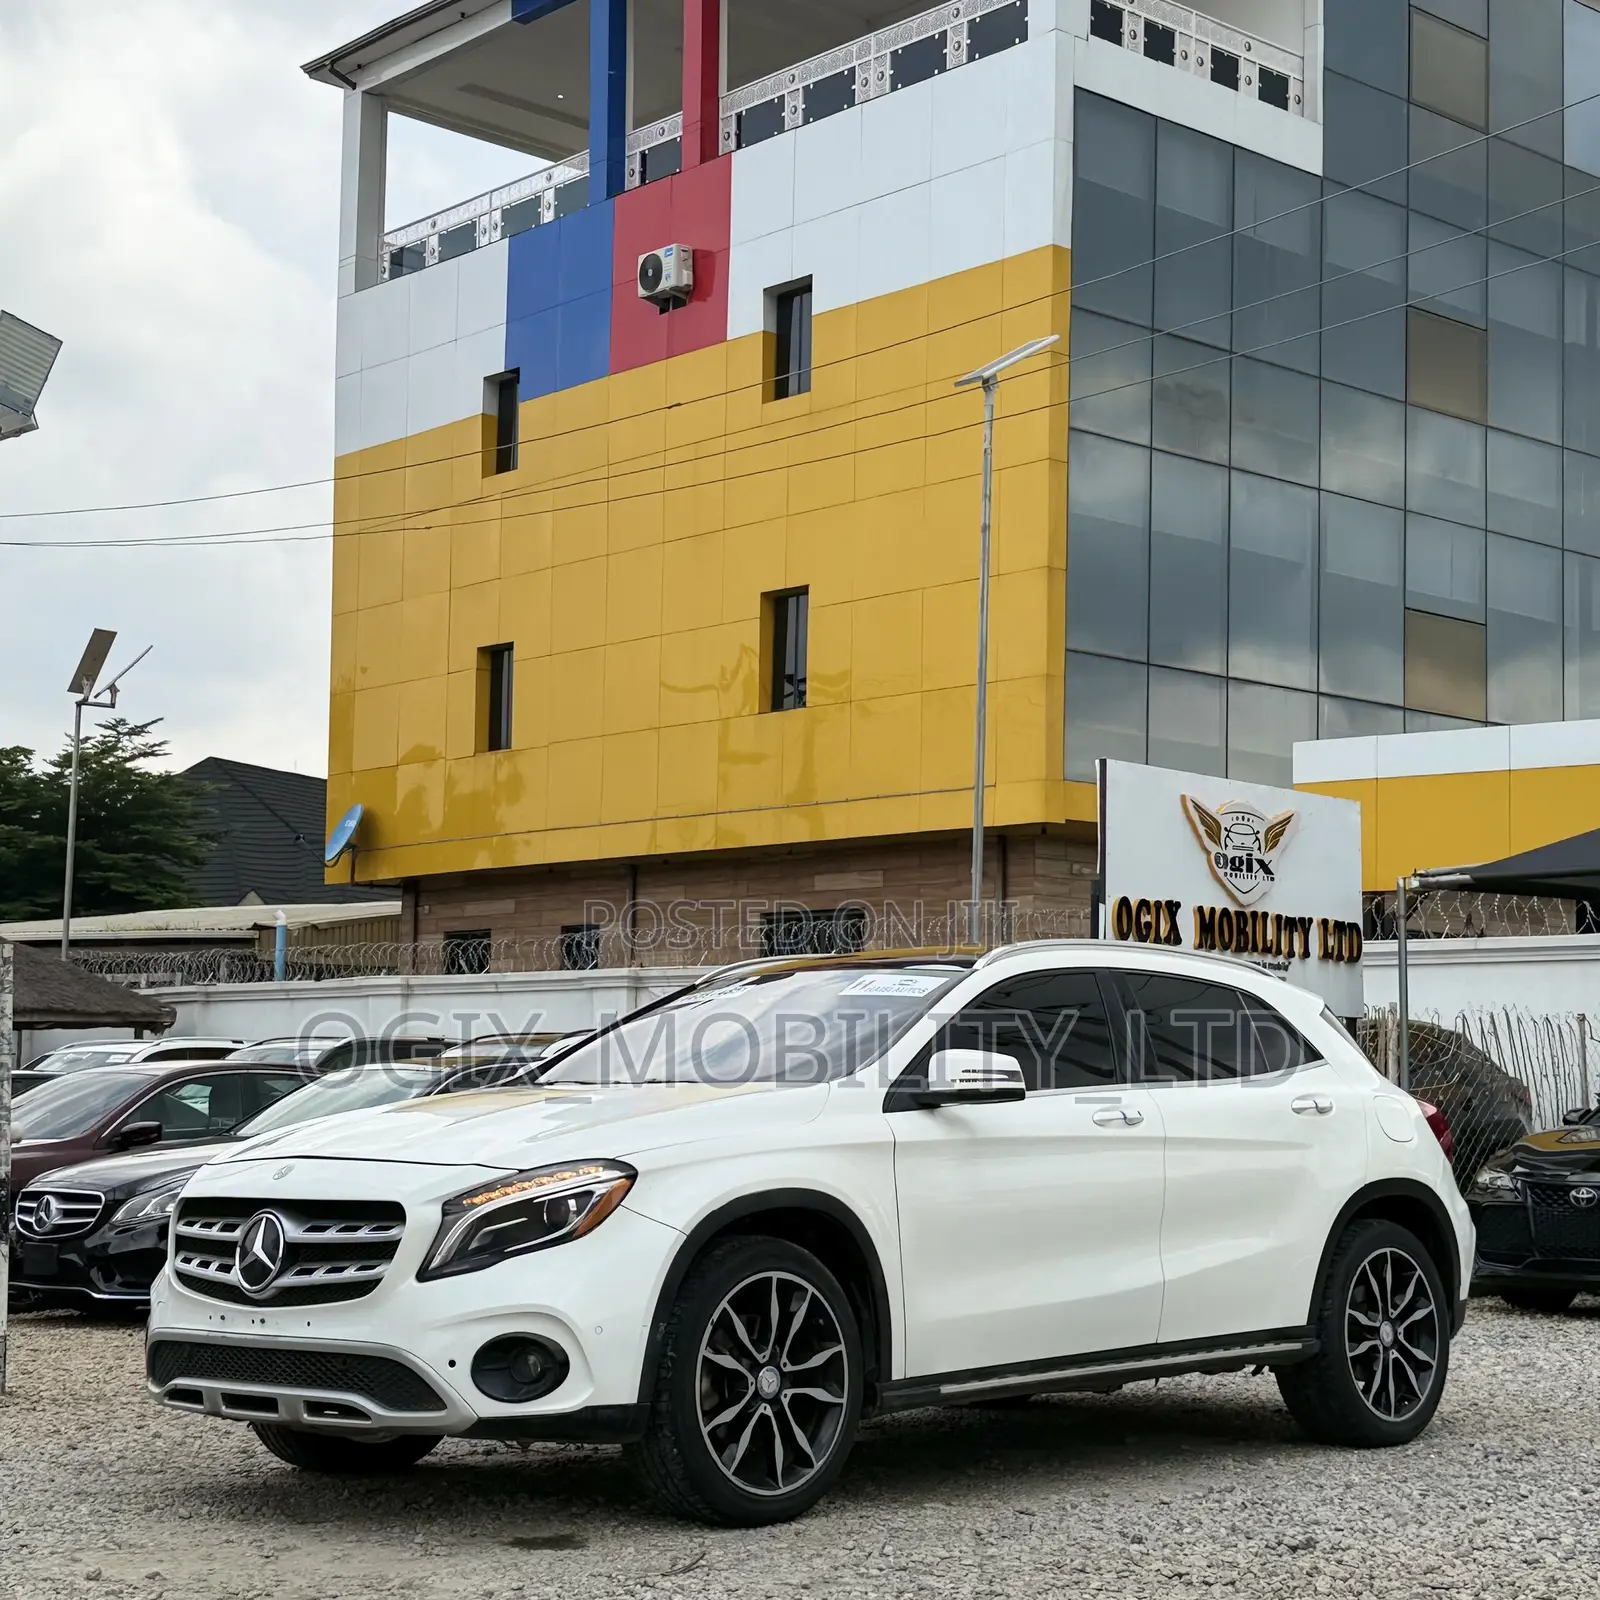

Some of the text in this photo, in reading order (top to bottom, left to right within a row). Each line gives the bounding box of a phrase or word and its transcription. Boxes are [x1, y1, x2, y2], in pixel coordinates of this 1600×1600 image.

[1112, 896, 1363, 963] OGIX MOBILITY LTD
